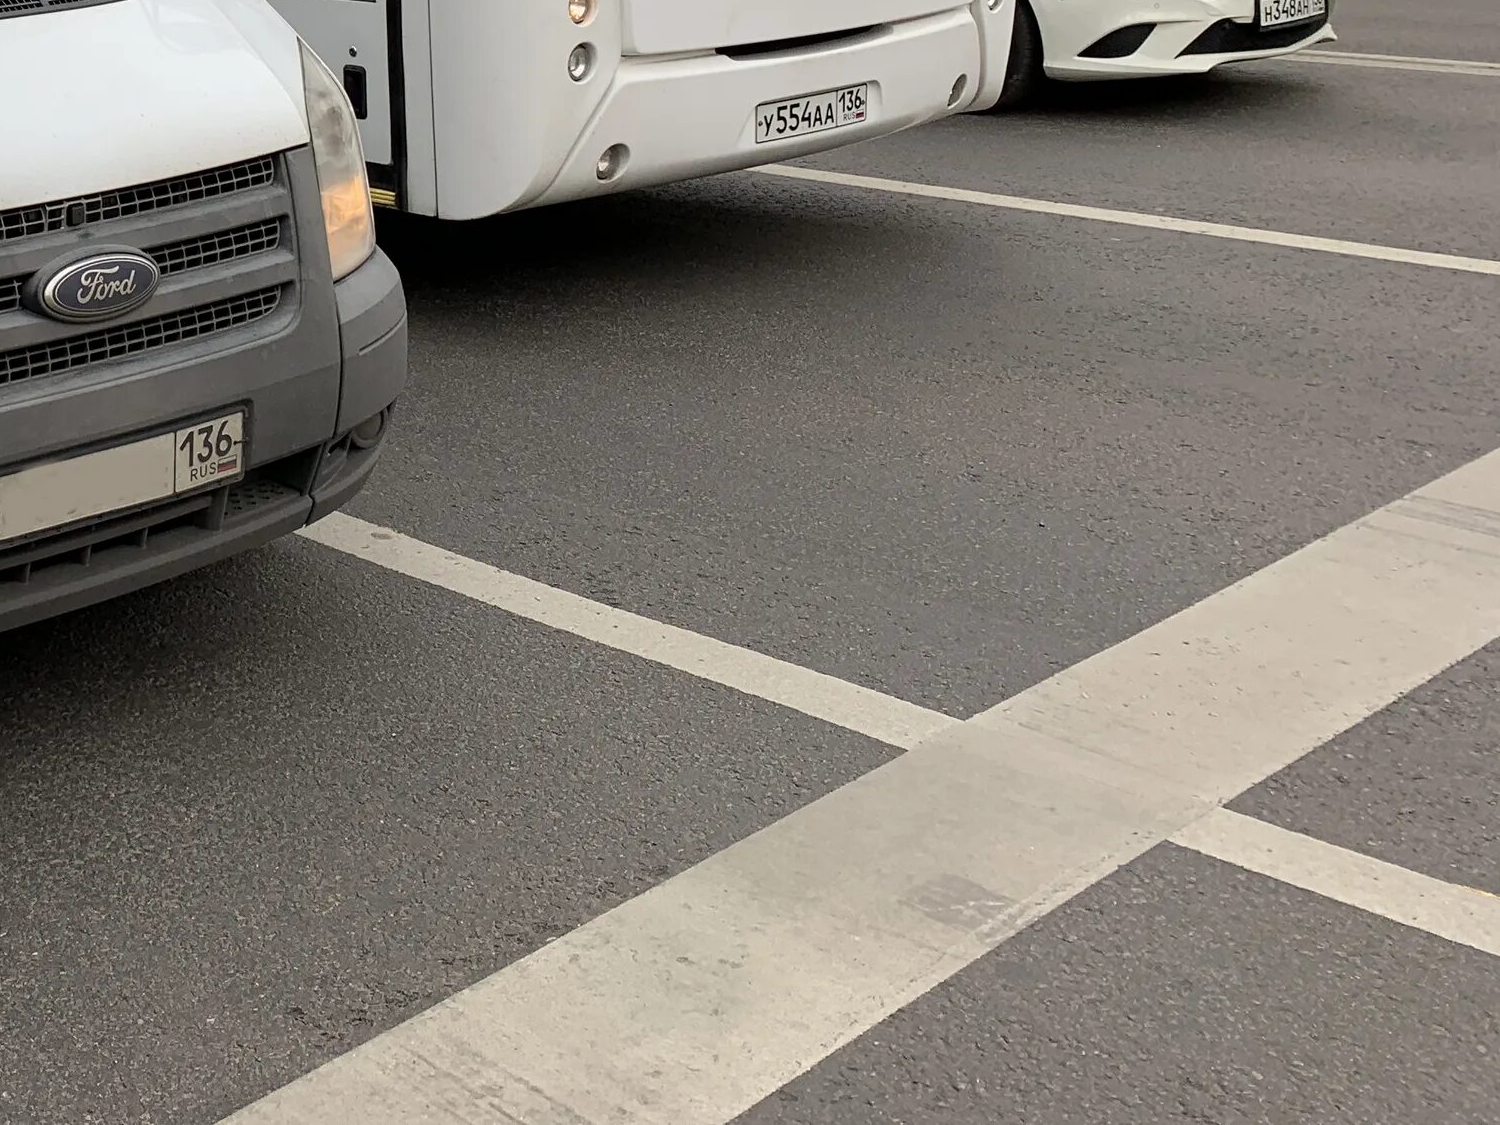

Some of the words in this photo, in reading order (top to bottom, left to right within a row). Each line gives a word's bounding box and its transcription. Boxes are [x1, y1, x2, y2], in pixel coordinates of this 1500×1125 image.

[763, 100, 835, 137] У554АА
[838, 88, 862, 113] 136
[843, 112, 856, 122] RUS
[77, 265, 137, 305] Ford
[180, 421, 233, 468] 136
[190, 461, 217, 482] RUS
